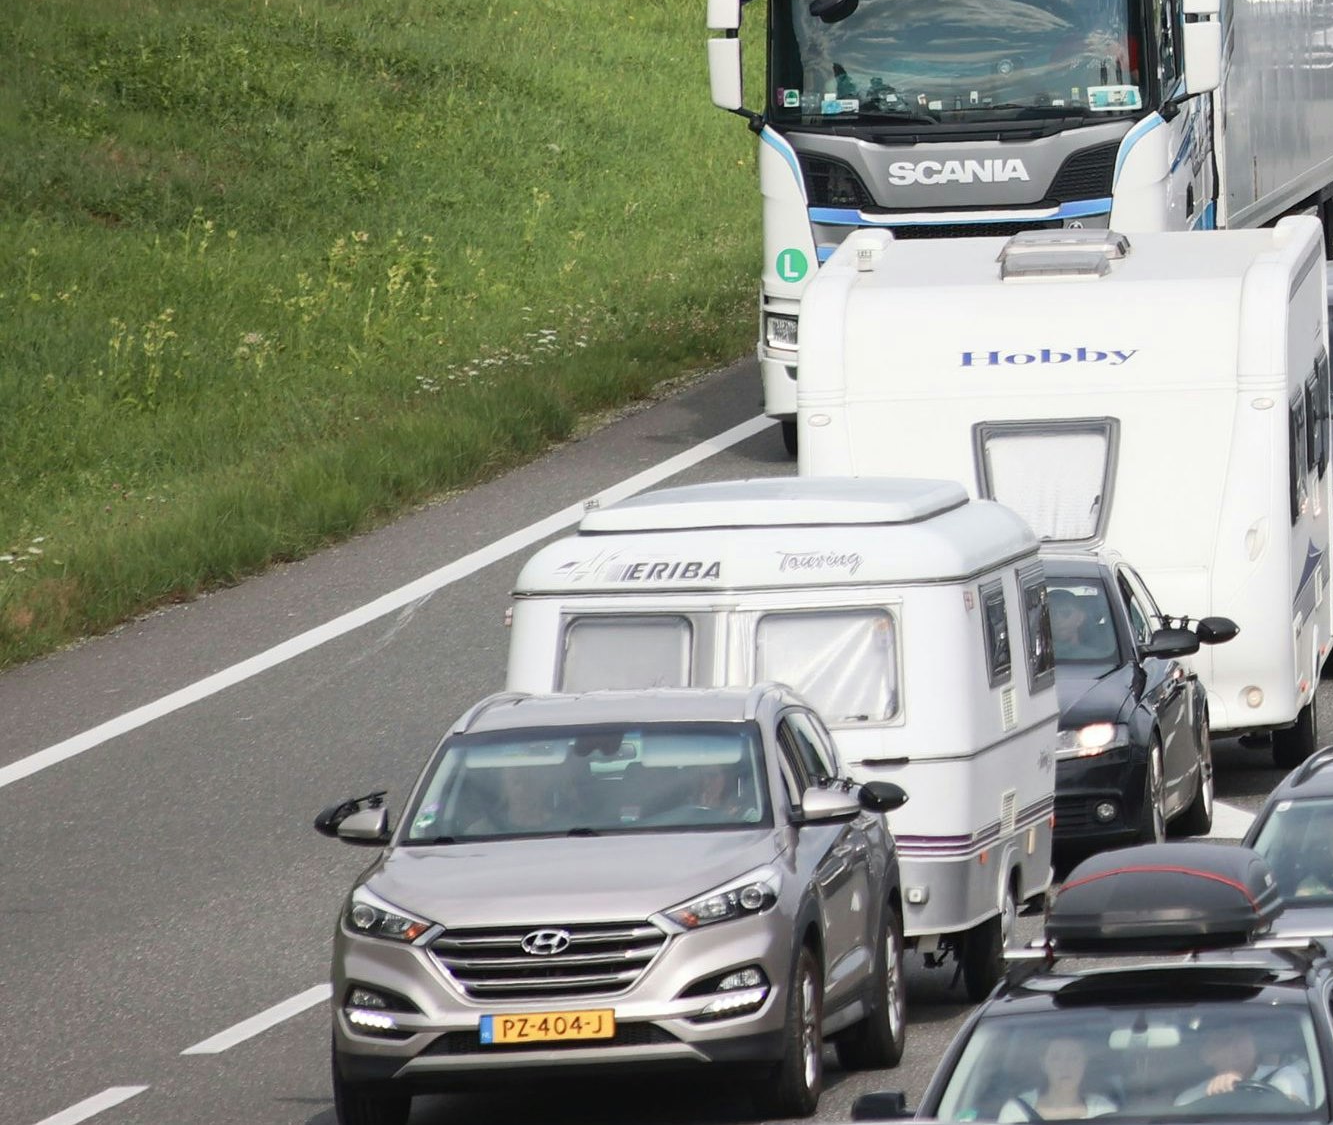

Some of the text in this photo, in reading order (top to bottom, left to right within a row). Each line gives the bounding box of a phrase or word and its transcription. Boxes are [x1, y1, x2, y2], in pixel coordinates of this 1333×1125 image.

[888, 158, 1031, 187] SCANIA
[783, 254, 799, 278] L
[958, 347, 1140, 367] Hobby
[627, 551, 864, 581] ERIBA Touring
[502, 1014, 603, 1039] PZ-404-J
